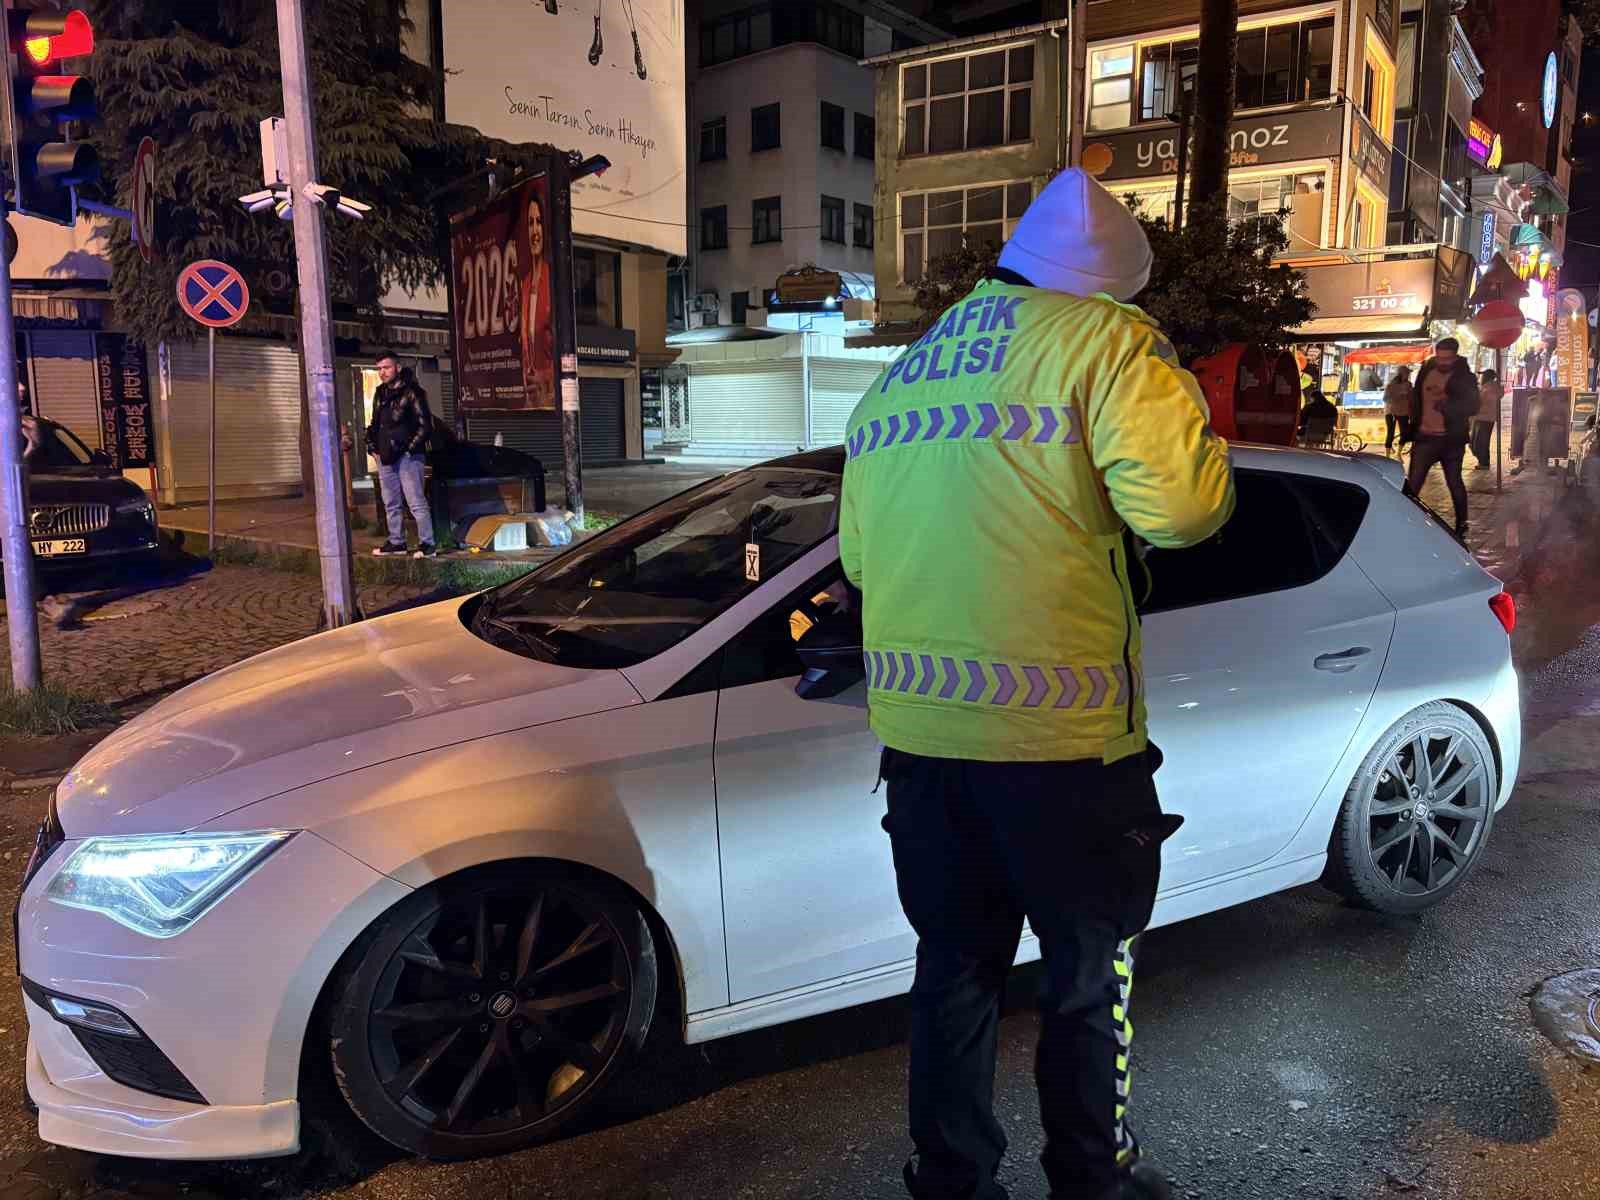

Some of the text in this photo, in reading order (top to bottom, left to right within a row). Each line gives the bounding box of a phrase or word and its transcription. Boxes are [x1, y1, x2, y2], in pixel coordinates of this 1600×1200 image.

[504, 86, 540, 118] Senin
[584, 109, 615, 138] Senin
[462, 240, 520, 340] 2026
[1352, 299, 1376, 310] 321
[1380, 298, 1397, 309] 00
[880, 335, 1011, 394] POLİSİ
[38, 540, 84, 553] HY 222
